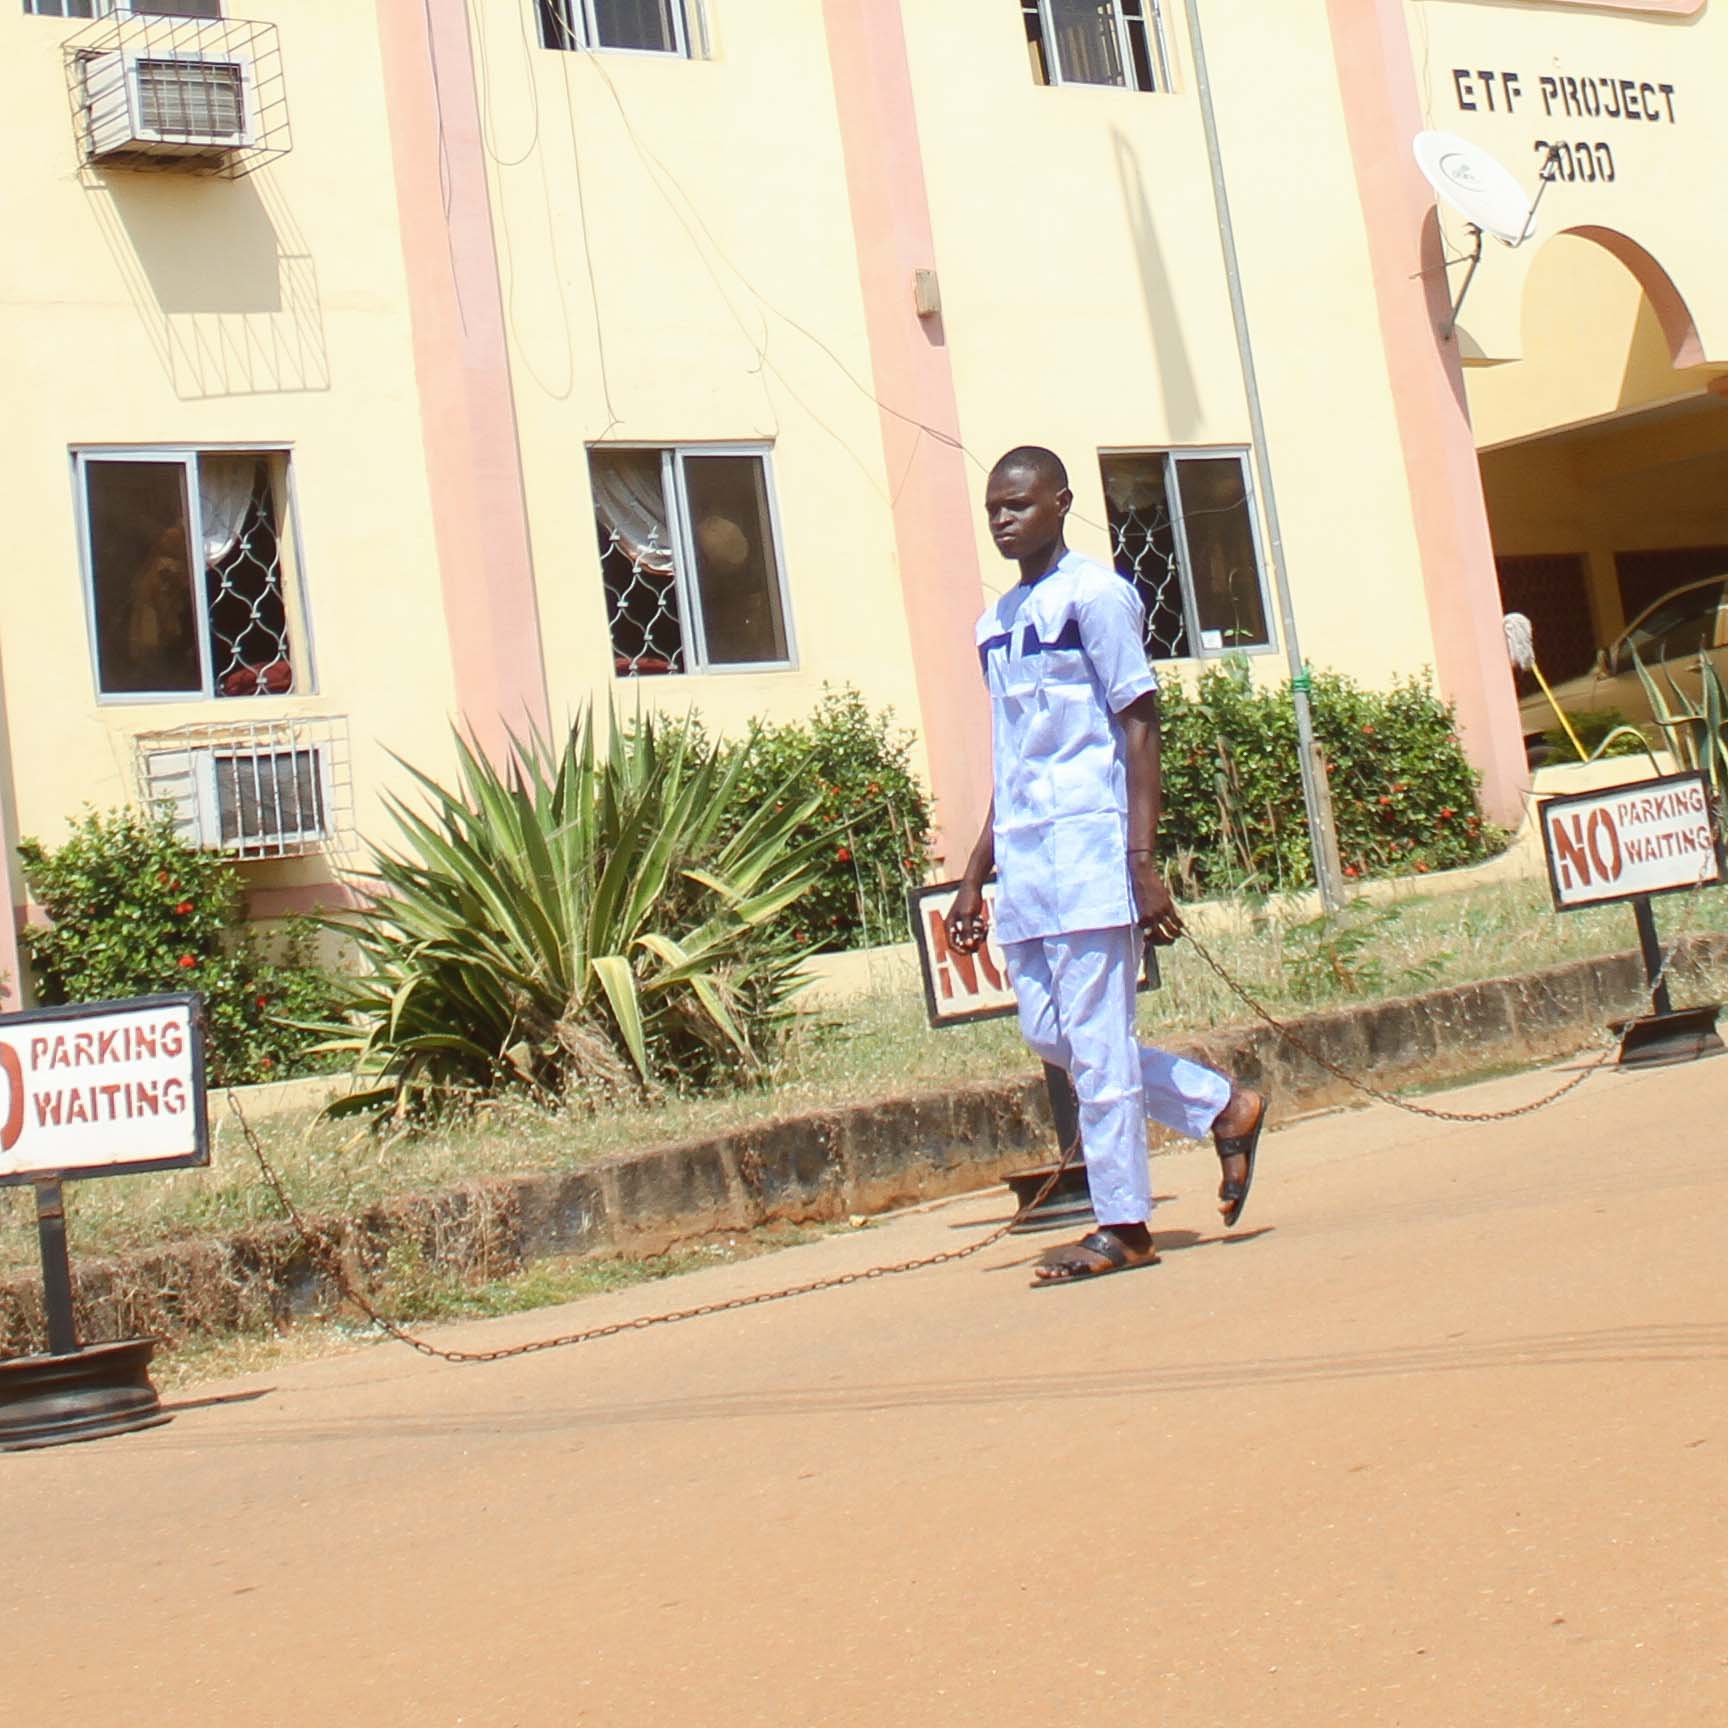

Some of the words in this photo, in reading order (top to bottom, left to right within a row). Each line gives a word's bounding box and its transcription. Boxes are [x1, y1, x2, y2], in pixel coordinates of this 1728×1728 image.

[1452, 69, 1521, 113] ETF
[1539, 76, 1676, 124] PROJECT
[1534, 140, 1616, 182] 2000
[1617, 788, 1703, 827] PARKING
[1552, 808, 1623, 890] NO
[1624, 826, 1712, 864] WAITING
[30, 1021, 183, 1071] PARKING
[34, 1078, 186, 1127] WAITING
